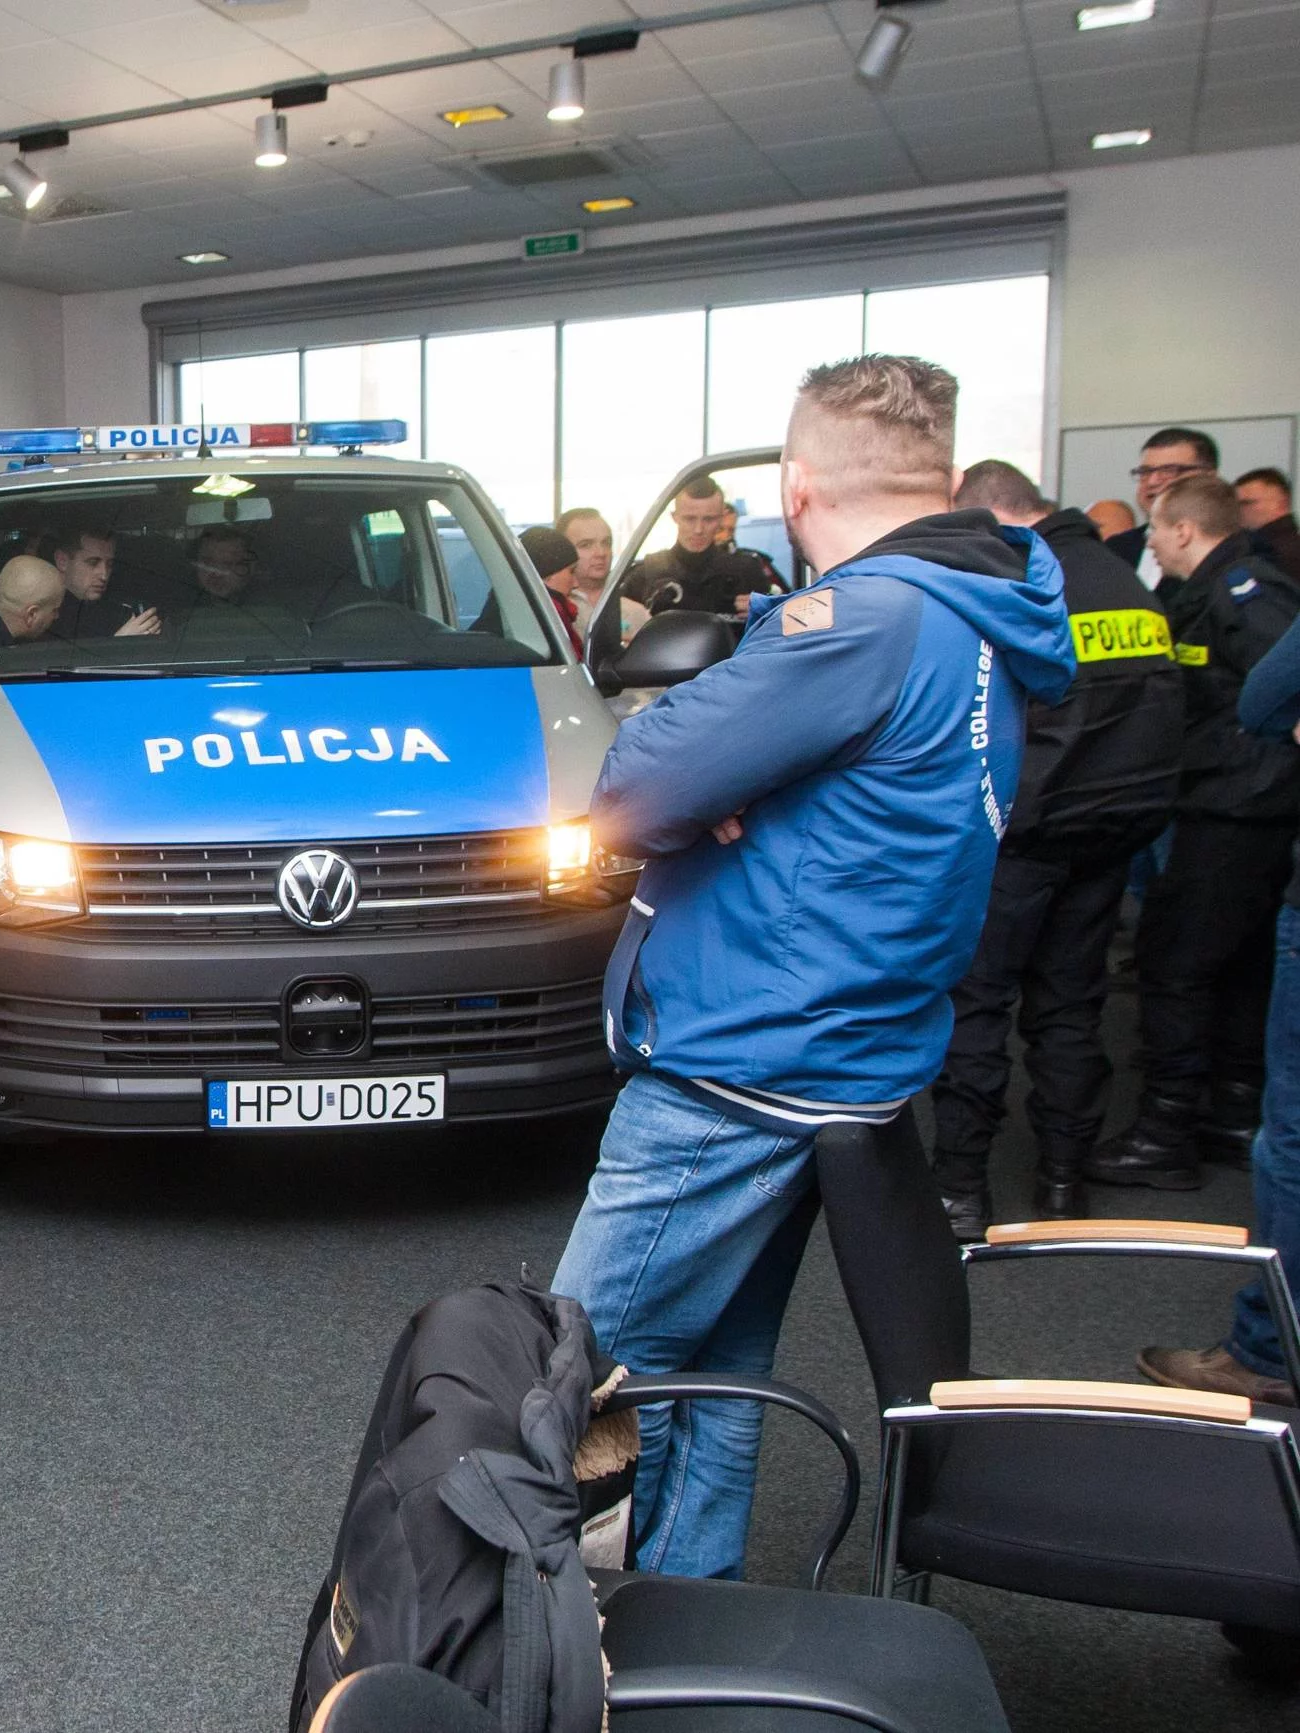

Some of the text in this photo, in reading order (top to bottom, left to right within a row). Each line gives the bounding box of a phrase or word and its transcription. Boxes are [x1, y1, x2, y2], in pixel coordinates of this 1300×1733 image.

[109, 427, 240, 448] POLICJA
[1078, 615, 1169, 655] POLIC
[969, 639, 993, 750] COLLEGE
[144, 727, 452, 774] POLICJA
[210, 1081, 437, 1122] PL HPU D025
